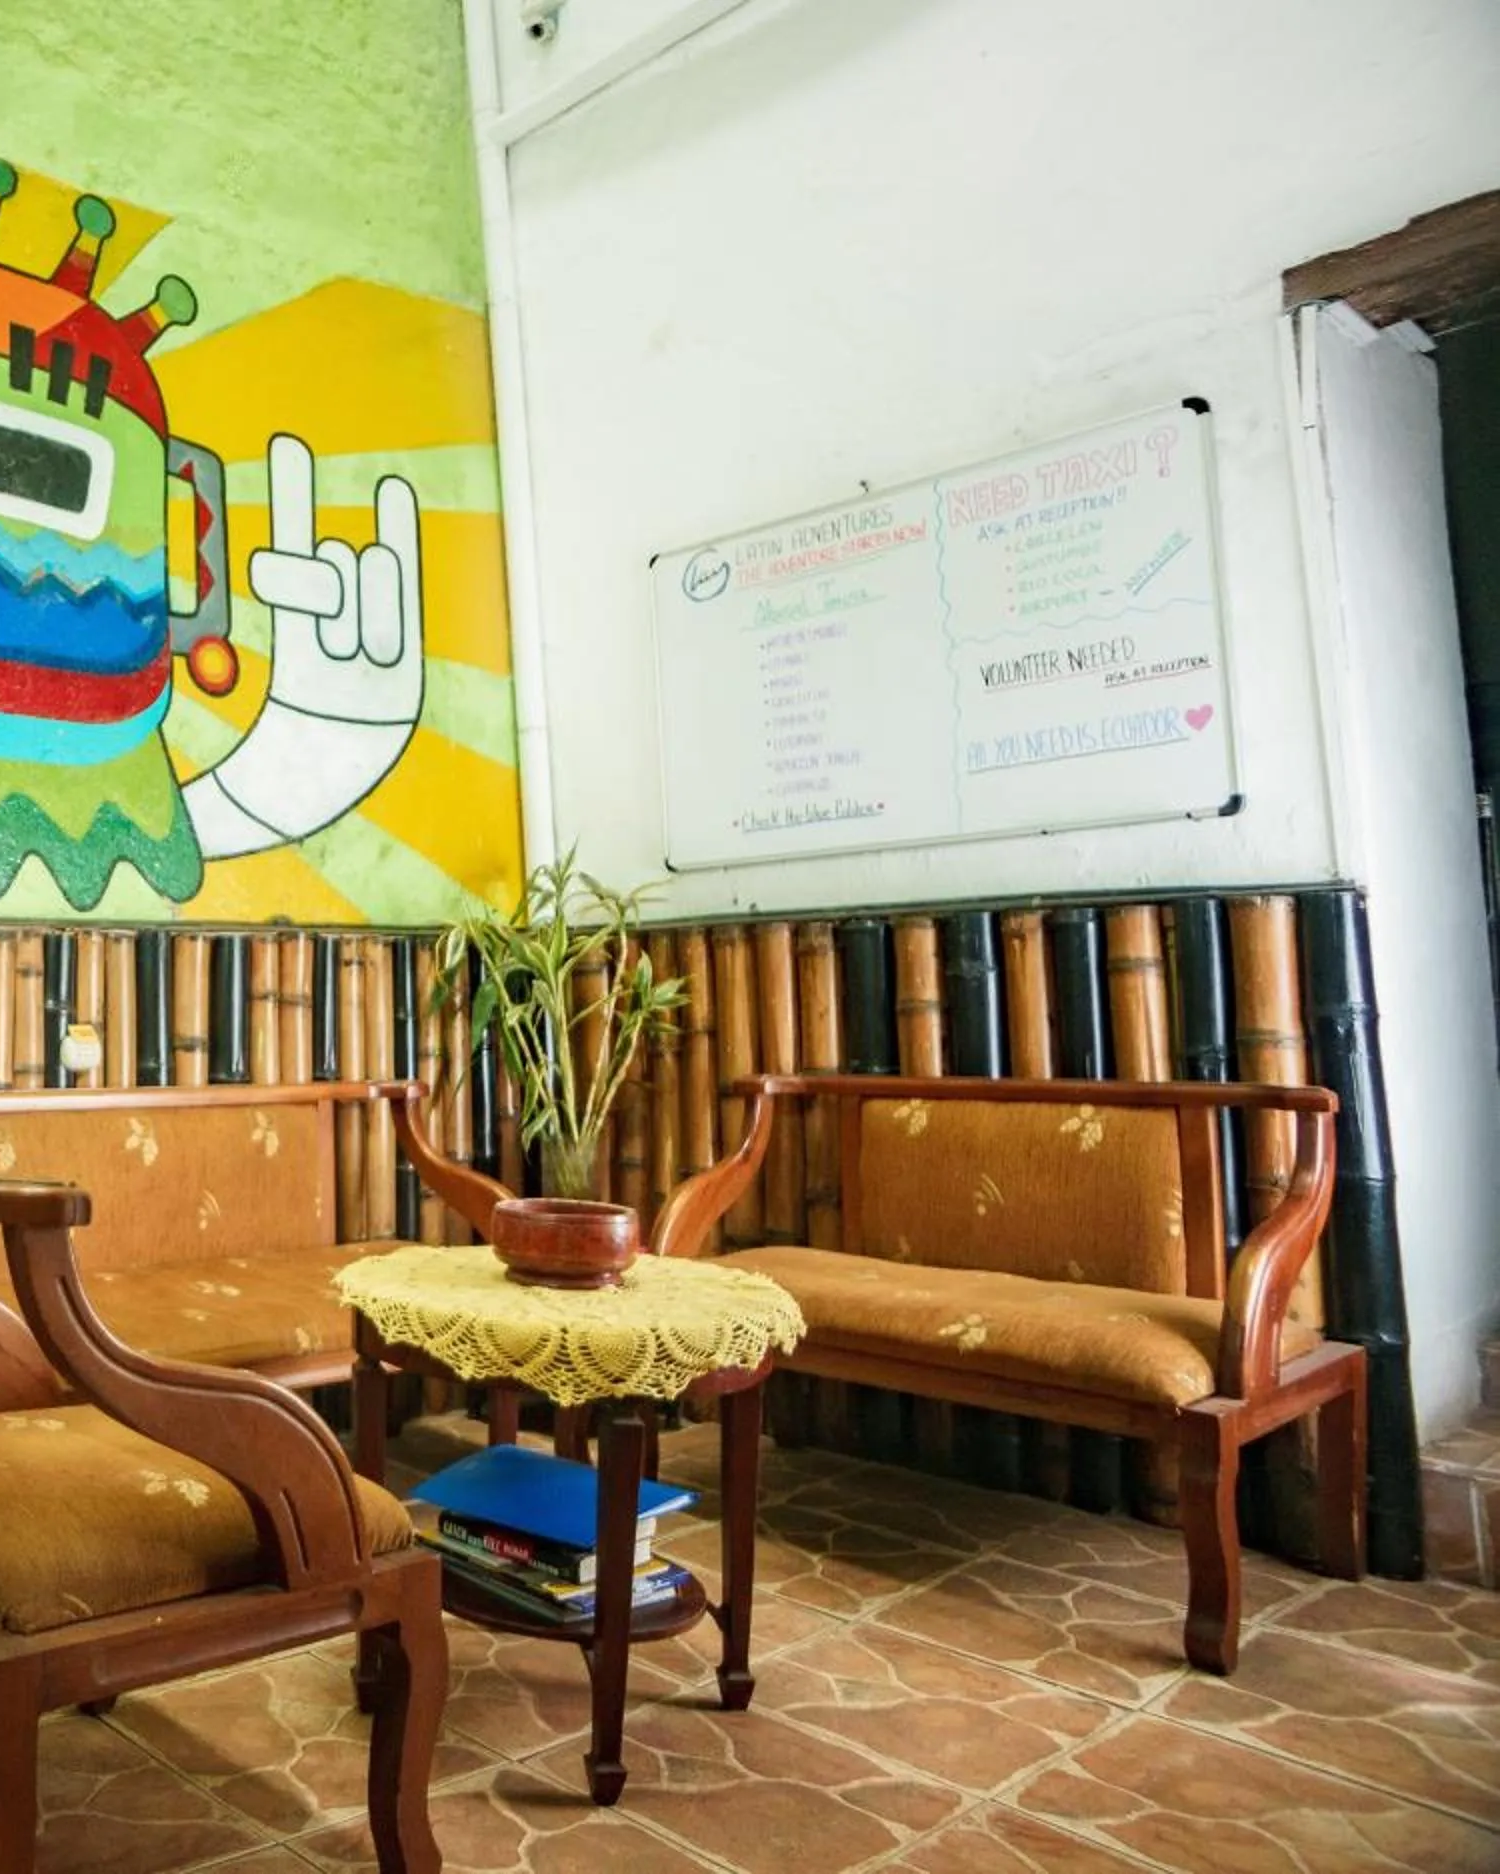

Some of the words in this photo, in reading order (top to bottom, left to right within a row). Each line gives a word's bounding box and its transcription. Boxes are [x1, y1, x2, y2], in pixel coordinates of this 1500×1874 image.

[946, 473, 1029, 528] NEED
[1036, 439, 1138, 499] TAXI
[735, 537, 783, 566] LATIN
[791, 504, 893, 550] ADVENTURES
[1067, 637, 1135, 672] NEEDED
